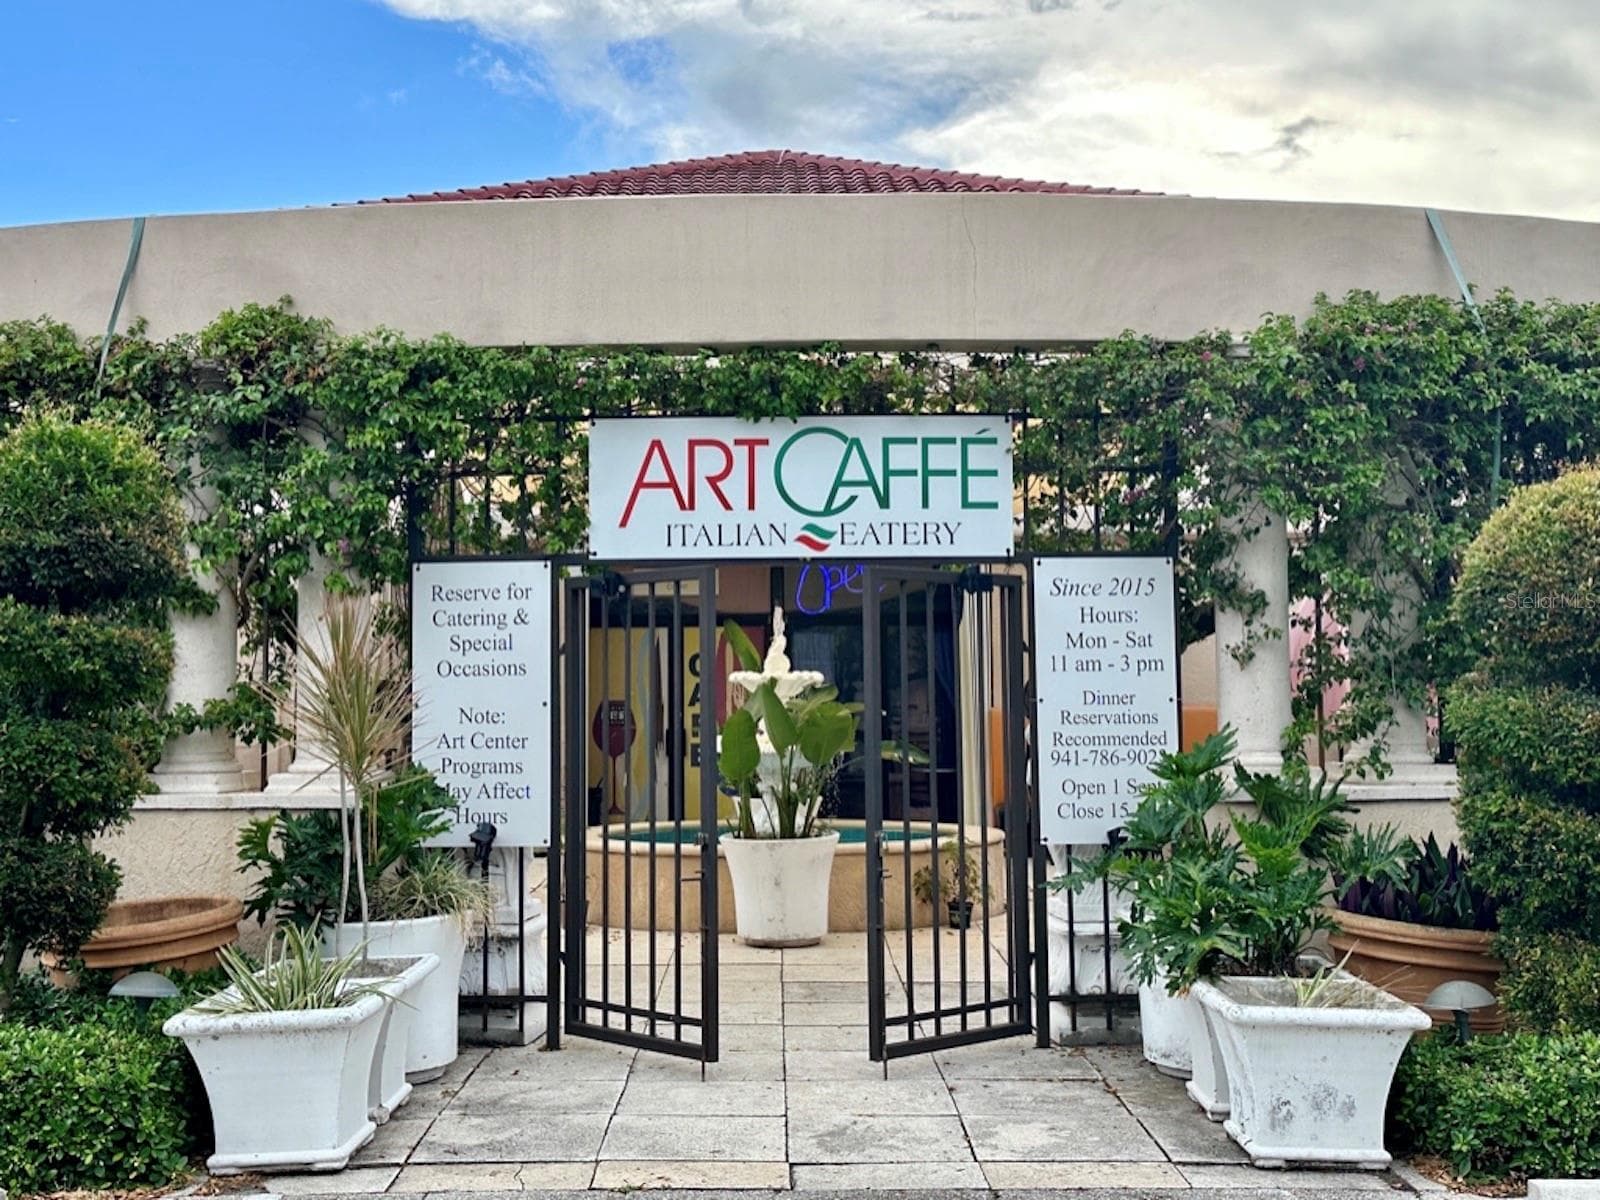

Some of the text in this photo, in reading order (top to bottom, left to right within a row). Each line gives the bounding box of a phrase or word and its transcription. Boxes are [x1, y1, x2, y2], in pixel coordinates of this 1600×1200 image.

[665, 521, 963, 548] ITALIAN EATERY
[431, 582, 532, 602] Reserve for
[1049, 577, 1156, 597] Since 2015
[432, 608, 530, 630] Catering &
[1079, 606, 1138, 624] Hours:
[449, 633, 513, 656] Special
[1065, 631, 1107, 649] Mon
[1125, 630, 1153, 648] Sat
[436, 659, 527, 678] Occasions
[1051, 655, 1067, 673] 11
[1075, 658, 1102, 673] am
[1120, 654, 1131, 672] 3
[1136, 657, 1165, 677] pm
[1082, 690, 1137, 706] Dinner
[458, 707, 506, 725] Note:
[1060, 708, 1160, 726] Reservations
[436, 731, 529, 750] Art Center
[1052, 730, 1168, 747] Recommended
[441, 757, 524, 779] Programs
[446, 781, 531, 804] ay Affect
[1061, 778, 1107, 800] Open
[1112, 778, 1120, 795] 1
[454, 807, 508, 825] Hours
[1057, 801, 1129, 820] Close 15
